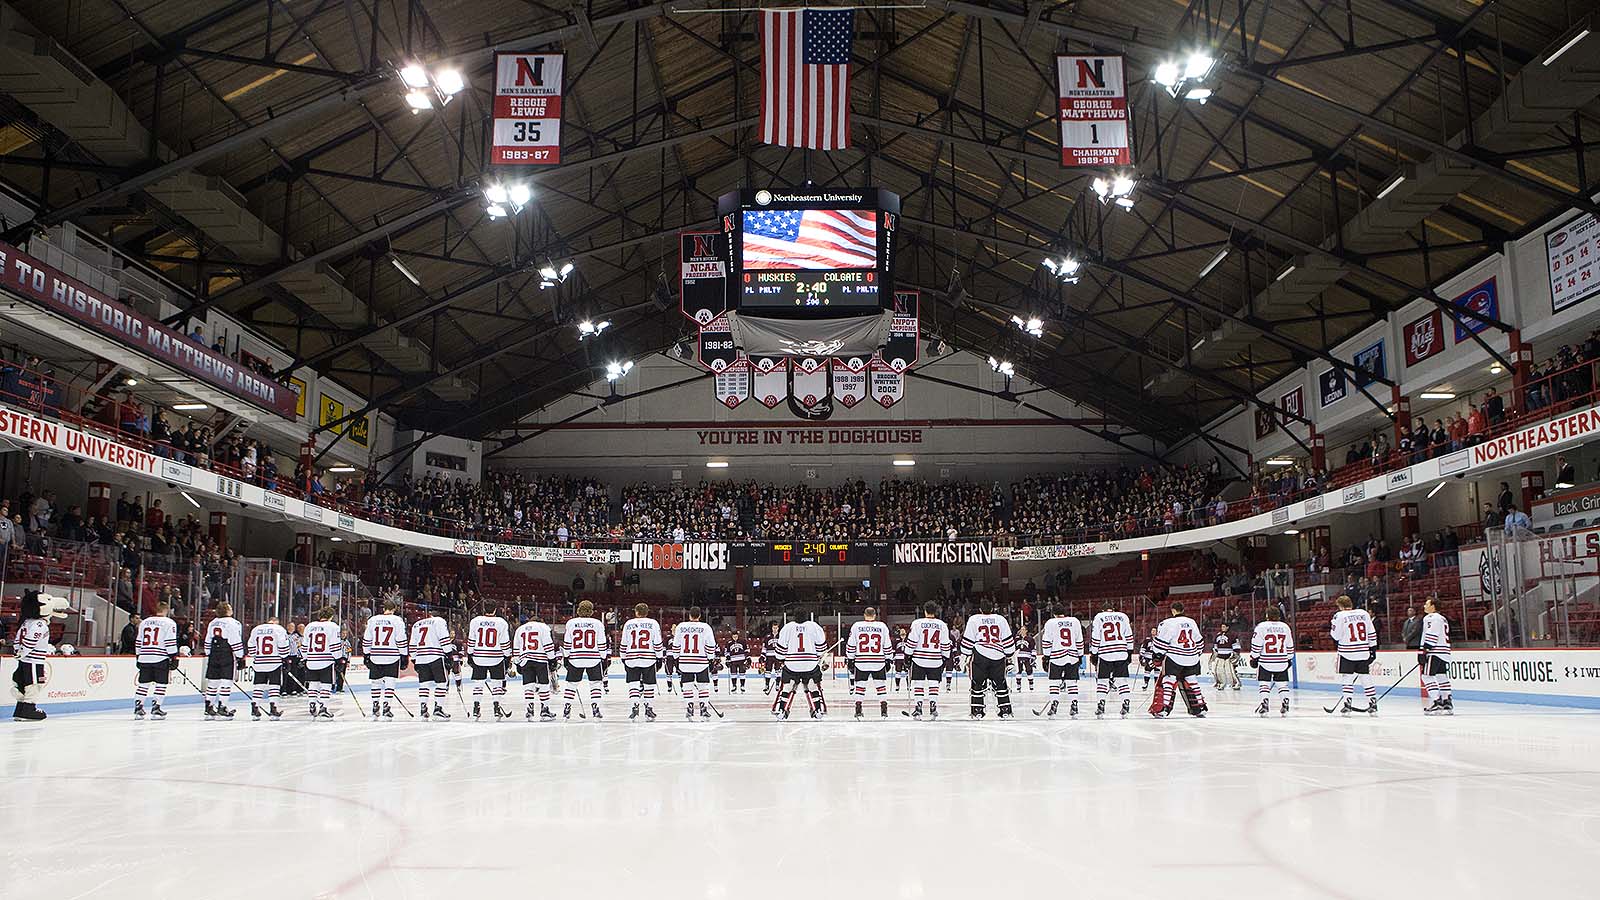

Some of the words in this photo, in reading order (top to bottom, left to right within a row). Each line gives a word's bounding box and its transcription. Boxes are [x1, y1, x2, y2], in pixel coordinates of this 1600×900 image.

[510, 98, 547, 107] REGGIE
[511, 107, 546, 117] LEWIS
[1073, 100, 1112, 109] GEORGE
[1062, 109, 1125, 119] MATTHEWS
[513, 122, 541, 142] 35
[1090, 124, 1099, 144] 1
[502, 150, 549, 160] 1983-87
[1073, 149, 1119, 157] CHAIRMAN
[773, 193, 822, 202] Northeastern
[823, 193, 862, 203] University
[690, 264, 719, 272] NCAA
[744, 272, 751, 283] 0
[758, 272, 796, 282] HUSKIES
[824, 272, 862, 282] COLGATE
[866, 272, 874, 283] 0
[796, 282, 827, 293] 2:40
[15, 259, 46, 293] TO
[52, 278, 143, 339] HISTORIC
[147, 325, 234, 384] MATTHEWS
[236, 371, 276, 404] ARENA
[704, 341, 733, 350] 1981-82
[1324, 389, 1343, 404] UCONN
[0, 410, 58, 446] STERN
[66, 431, 157, 474] UNIVERSITY
[697, 431, 758, 445] YOU'RE
[763, 431, 782, 444] IN
[787, 431, 824, 443] THE
[828, 430, 922, 443] DOGHOUSE
[1474, 409, 1600, 465] NORTHEASTERN
[1555, 501, 1579, 516] Jack
[784, 551, 791, 562] 0
[838, 551, 846, 561] 0
[803, 543, 826, 554] 2:40
[895, 542, 992, 564] NORTHEASTERN
[374, 626, 394, 646] 17
[418, 627, 429, 646] 7
[477, 628, 497, 647] 10
[572, 629, 596, 649] 20
[630, 630, 651, 649] 12
[922, 629, 940, 649] 14
[978, 625, 1000, 643] 39
[1059, 628, 1072, 647] 9
[1103, 622, 1123, 641] 21
[1177, 629, 1196, 648] 41
[1348, 622, 1367, 642] 18
[256, 636, 273, 655] 16
[308, 633, 326, 652] 19
[520, 632, 539, 651] 15
[683, 634, 699, 653] 11
[796, 633, 805, 652] 1
[858, 634, 882, 653] 23
[1264, 634, 1286, 653] 27
[1446, 661, 1482, 681] ROTECT
[1486, 661, 1510, 682] THIS
[1513, 660, 1558, 683] HOUSE.
